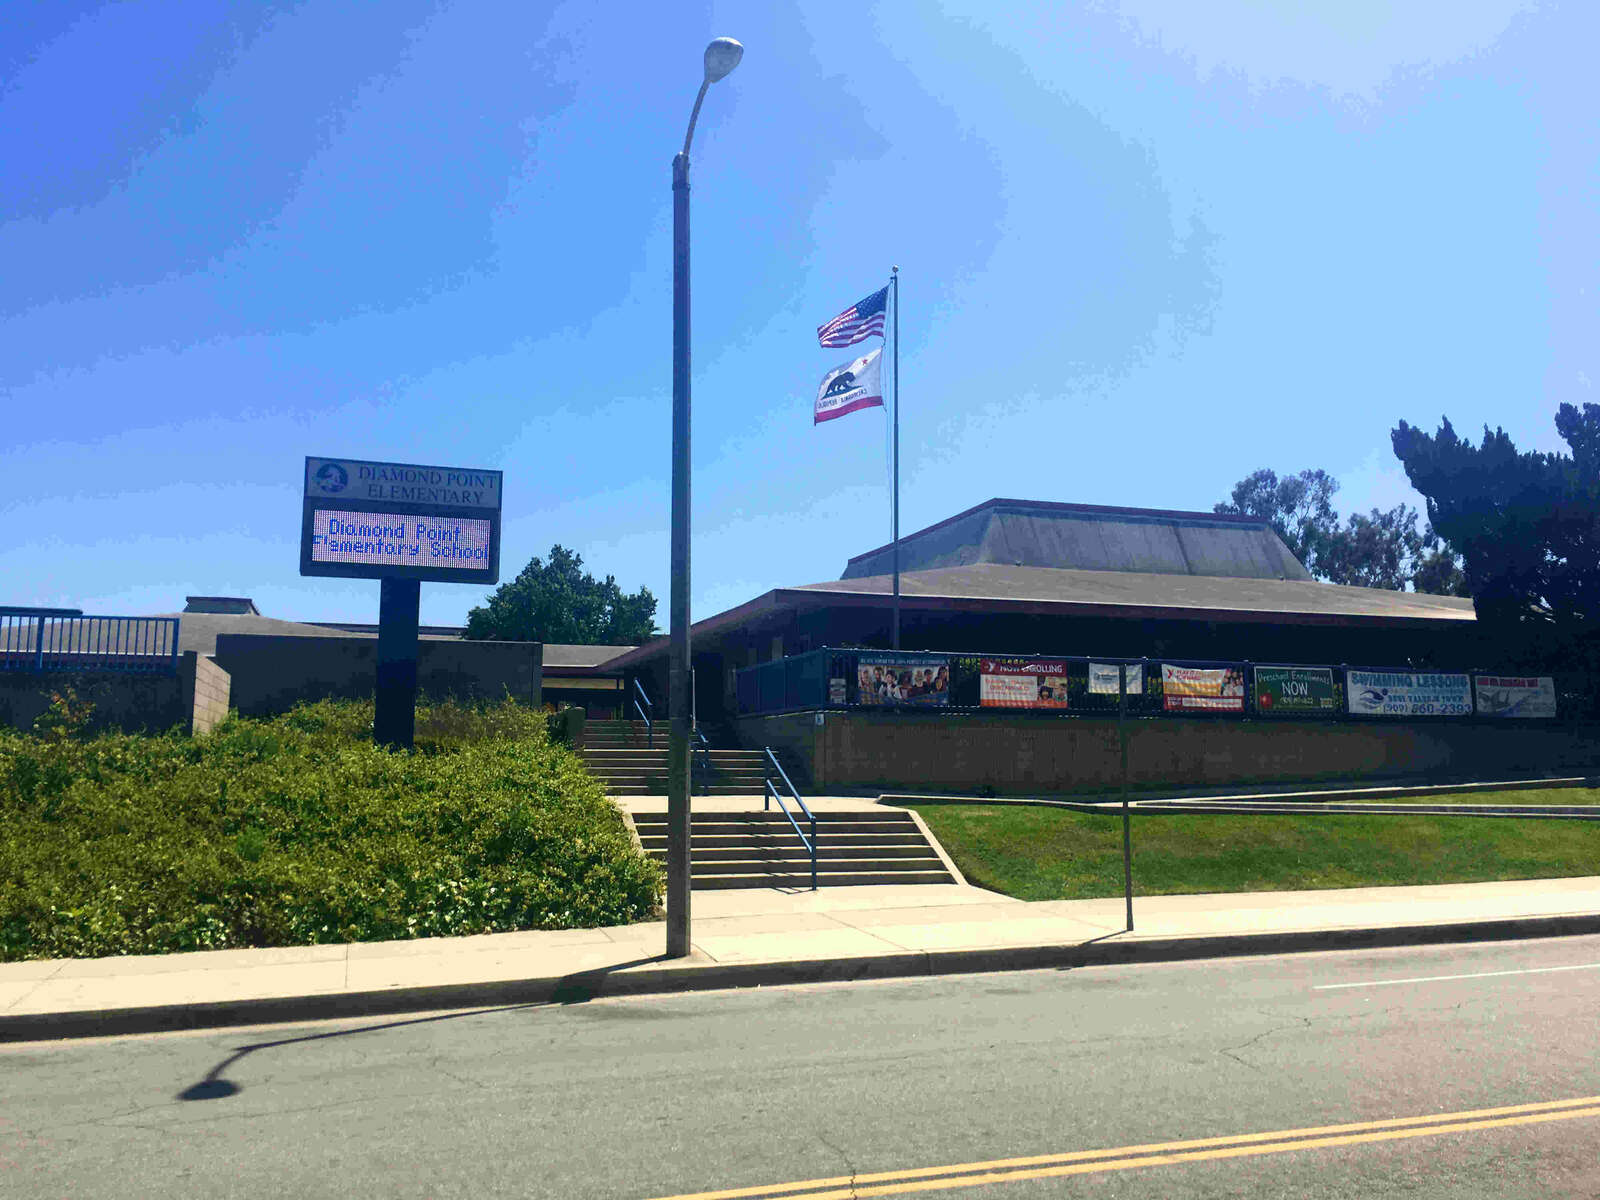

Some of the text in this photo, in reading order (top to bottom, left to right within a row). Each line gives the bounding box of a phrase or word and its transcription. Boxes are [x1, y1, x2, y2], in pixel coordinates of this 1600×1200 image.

[359, 466, 498, 489] DIAMOND POINT
[367, 483, 484, 505] ELEMENTARY
[328, 518, 461, 542] Diamond Point
[312, 534, 488, 560] Elementary School
[1281, 681, 1308, 696] NOW
[1351, 672, 1414, 688] SWIMMING
[1416, 674, 1469, 688] LESSONS
